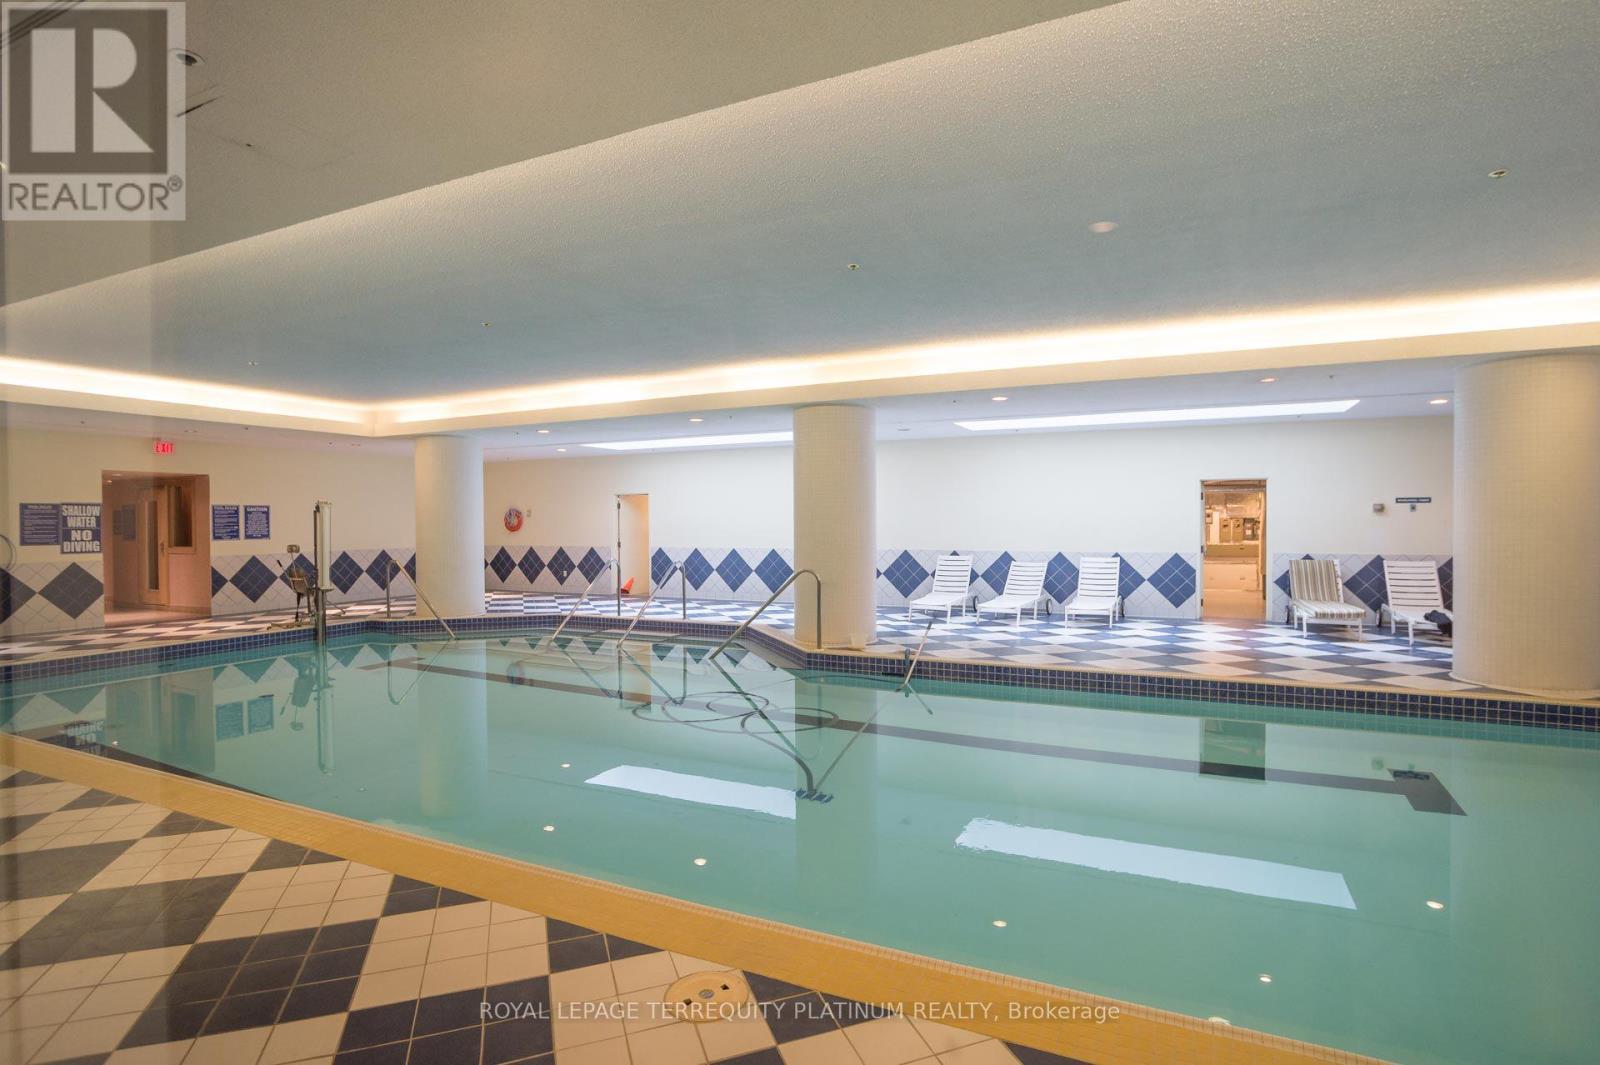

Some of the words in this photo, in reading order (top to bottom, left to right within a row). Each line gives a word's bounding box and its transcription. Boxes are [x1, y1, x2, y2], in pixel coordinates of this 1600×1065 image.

[156, 442, 174, 453] EXIT
[62, 505, 100, 516] SHALLOW
[67, 516, 96, 528] WATER
[71, 529, 93, 541] NO
[63, 541, 100, 552] DIVING
